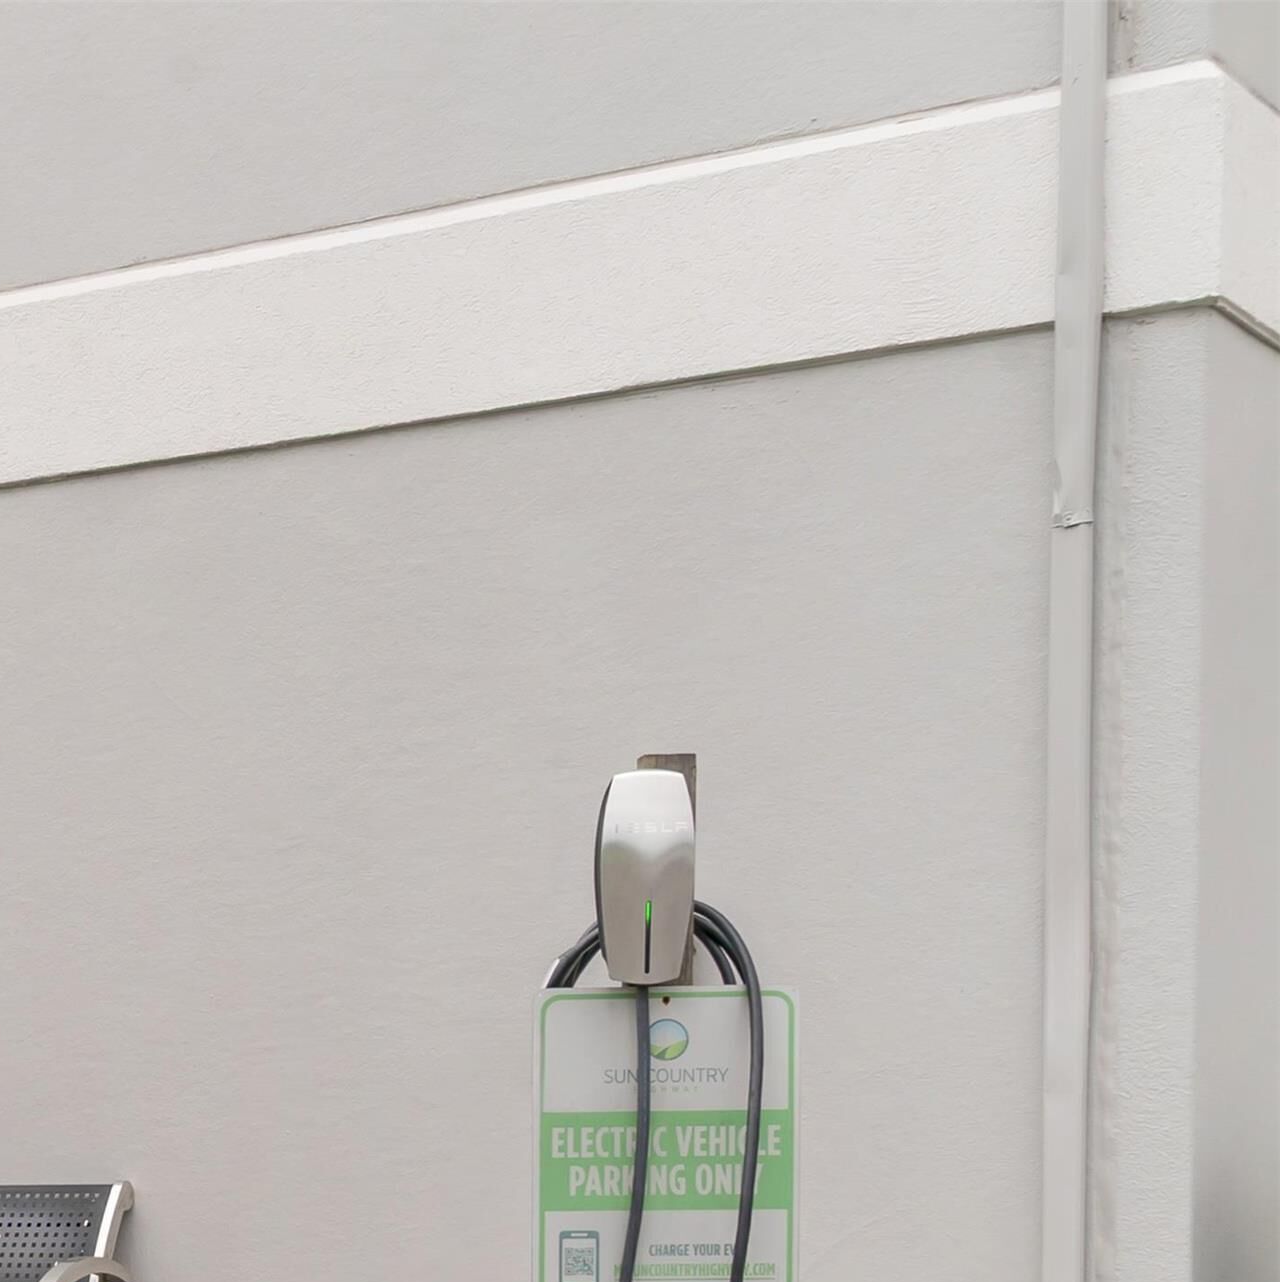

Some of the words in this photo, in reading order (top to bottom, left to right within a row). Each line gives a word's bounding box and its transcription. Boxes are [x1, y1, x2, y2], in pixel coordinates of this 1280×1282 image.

[648, 1067, 729, 1083] COUNTRY
[551, 1126, 668, 1158] ELECTRC
[569, 1164, 687, 1197] PARKNG
[648, 1244, 690, 1257] CHARGE
[693, 1244, 721, 1256] YOUR
[724, 1243, 737, 1256] EV
